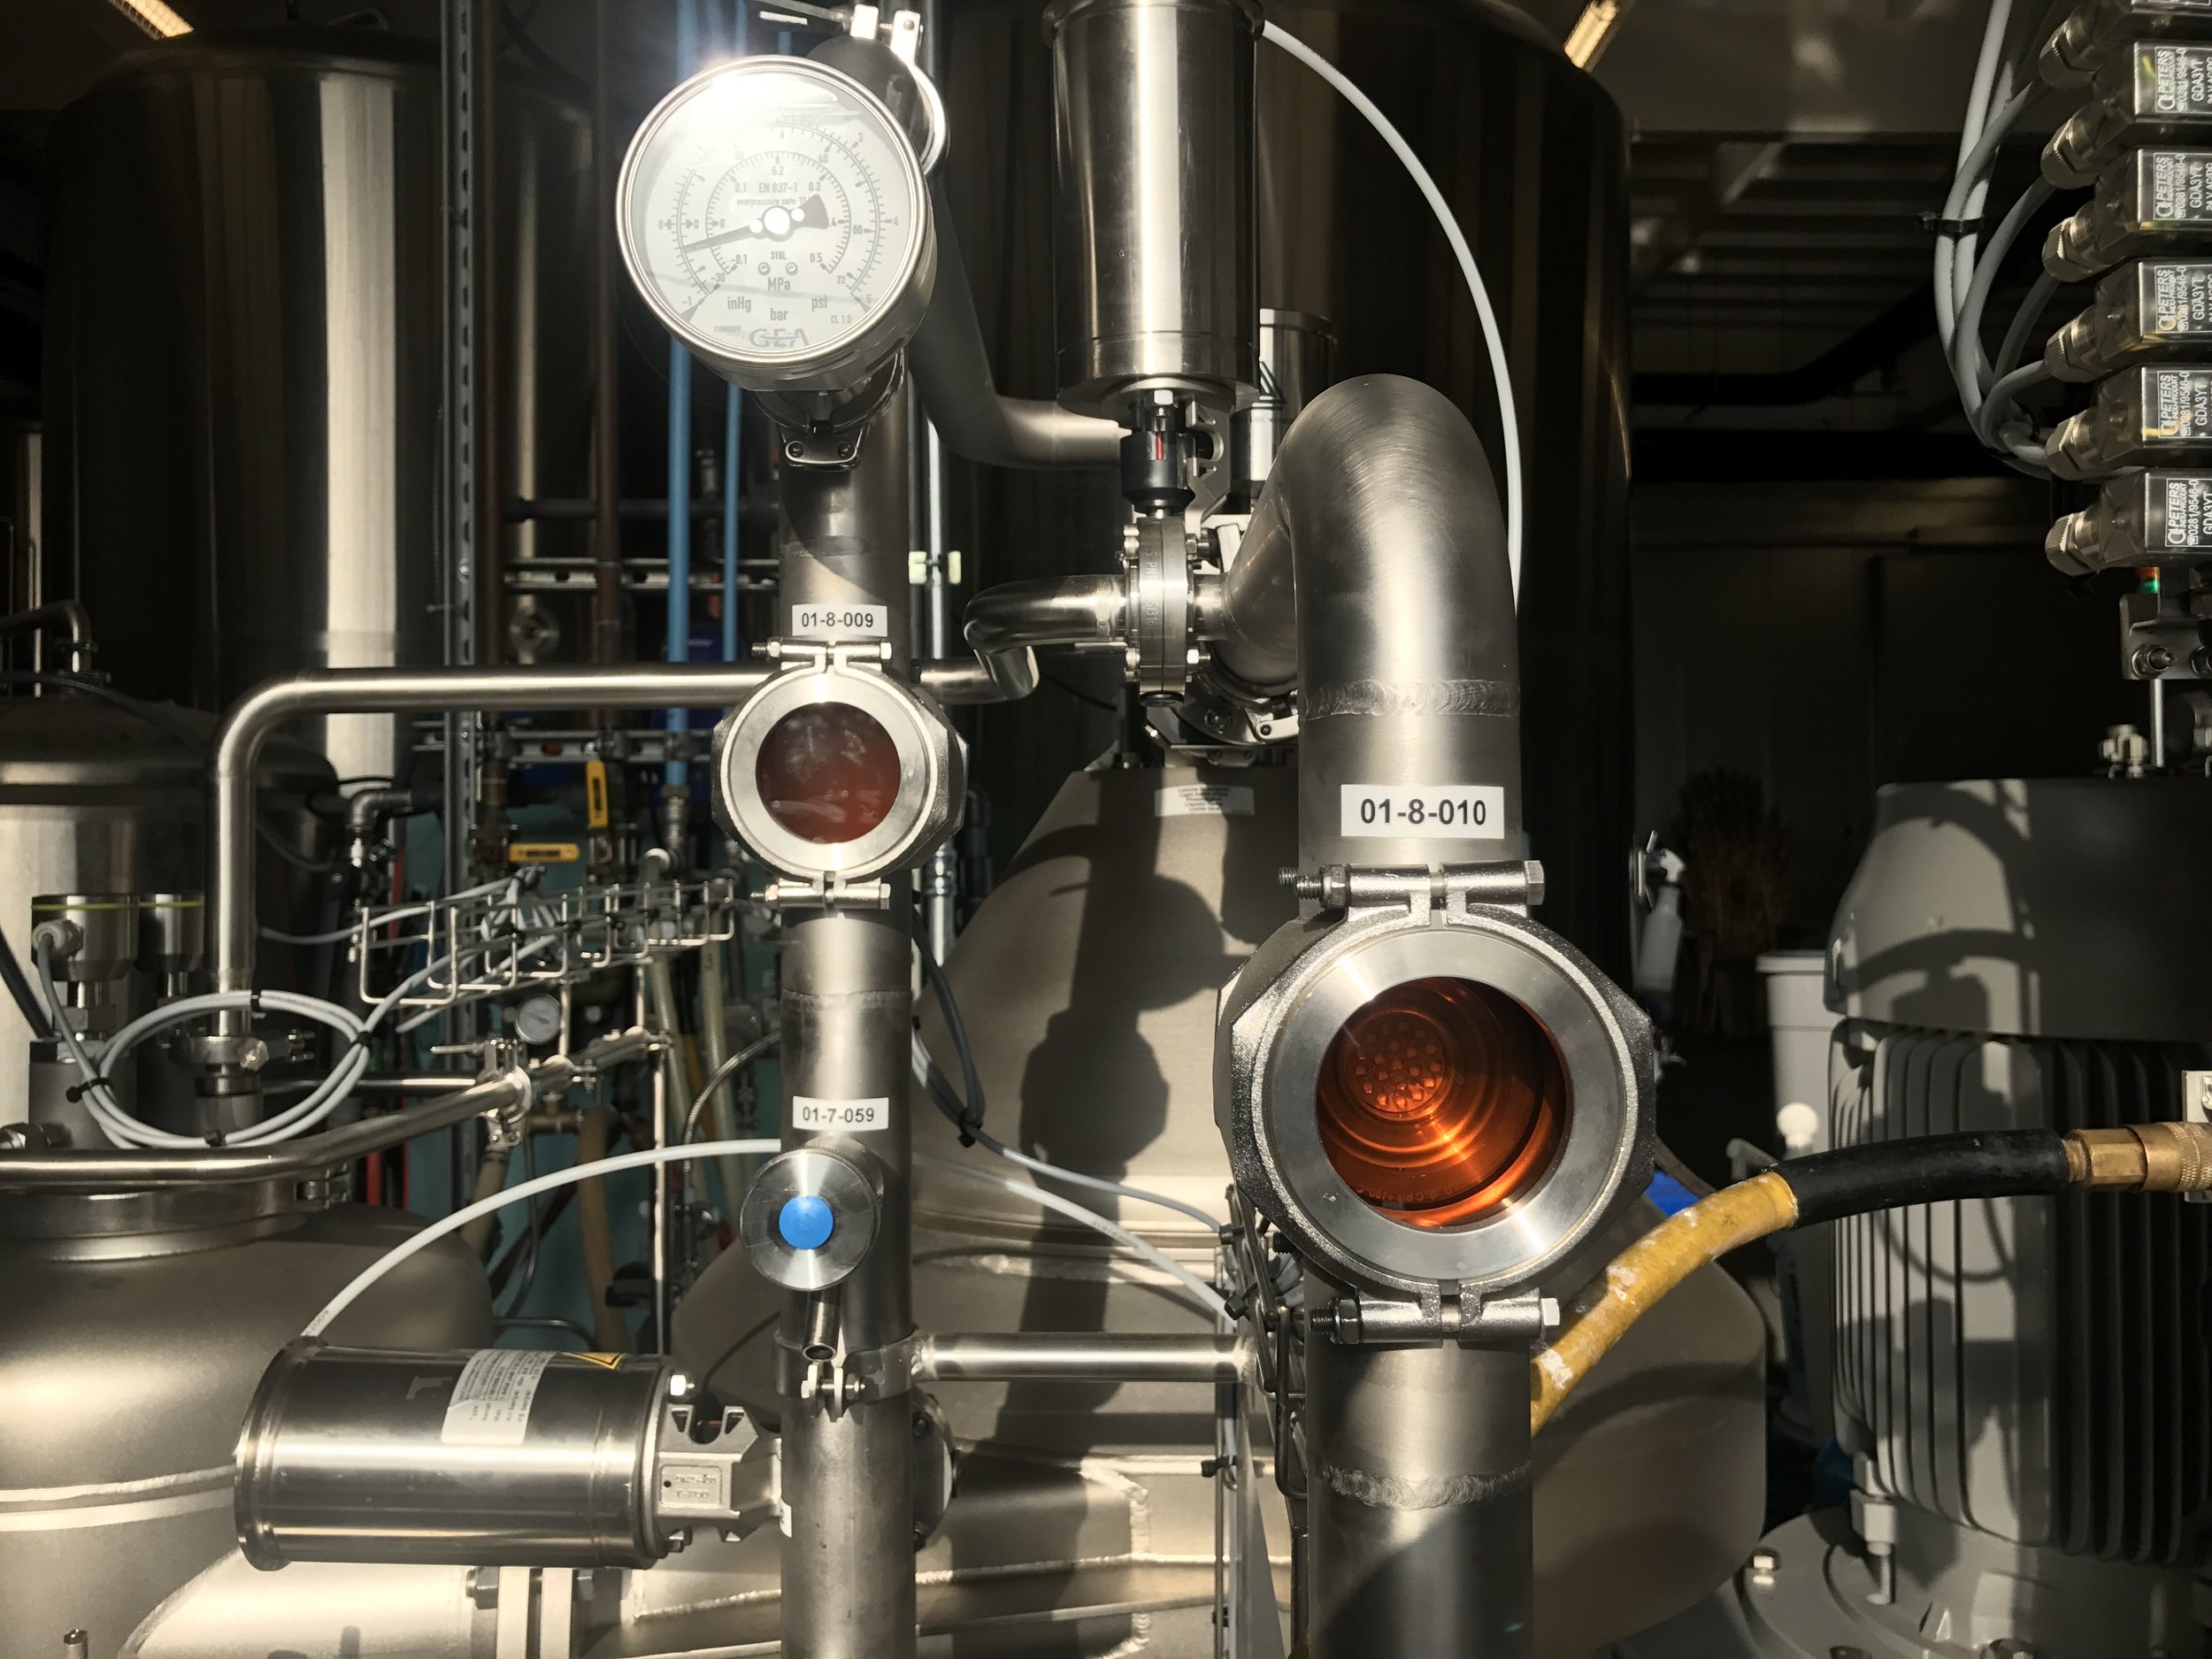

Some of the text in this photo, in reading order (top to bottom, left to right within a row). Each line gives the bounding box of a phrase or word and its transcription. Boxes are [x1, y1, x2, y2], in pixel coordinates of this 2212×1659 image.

[2157, 50, 2168, 94] PETERS
[857, 132, 864, 143] 3
[818, 154, 828, 164] 40
[809, 180, 821, 192] 0.3
[2155, 156, 2168, 202] PETERS
[758, 182, 771, 193] EN
[658, 219, 664, 229] 0
[694, 219, 699, 228] 0
[719, 219, 726, 228] 0
[852, 225, 863, 235] 60
[731, 254, 747, 264] -0.1
[810, 253, 823, 264] 0.5
[710, 273, 726, 283] -30
[768, 277, 791, 290] MPa
[837, 275, 846, 284] 72
[2157, 269, 2170, 317] PETERS
[2192, 277, 2205, 320] GDA3YT
[682, 296, 692, 307] -1
[727, 296, 752, 312] inHg
[811, 295, 827, 311] psi
[770, 307, 788, 320] bar
[749, 328, 810, 348] GEA
[2160, 374, 2172, 419] PETERS
[2170, 375, 2178, 419] INDU-PRODUKT
[2194, 382, 2208, 426] GDA3YT
[2168, 482, 2180, 528] PETERS
[2187, 480, 2200, 535] 0281/9546-0
[2202, 491, 2212, 535] GDA3YT
[802, 611, 874, 627] 01-8-009
[1361, 798, 1487, 825] 01-8-010
[803, 1106, 875, 1123] 01-7-059
